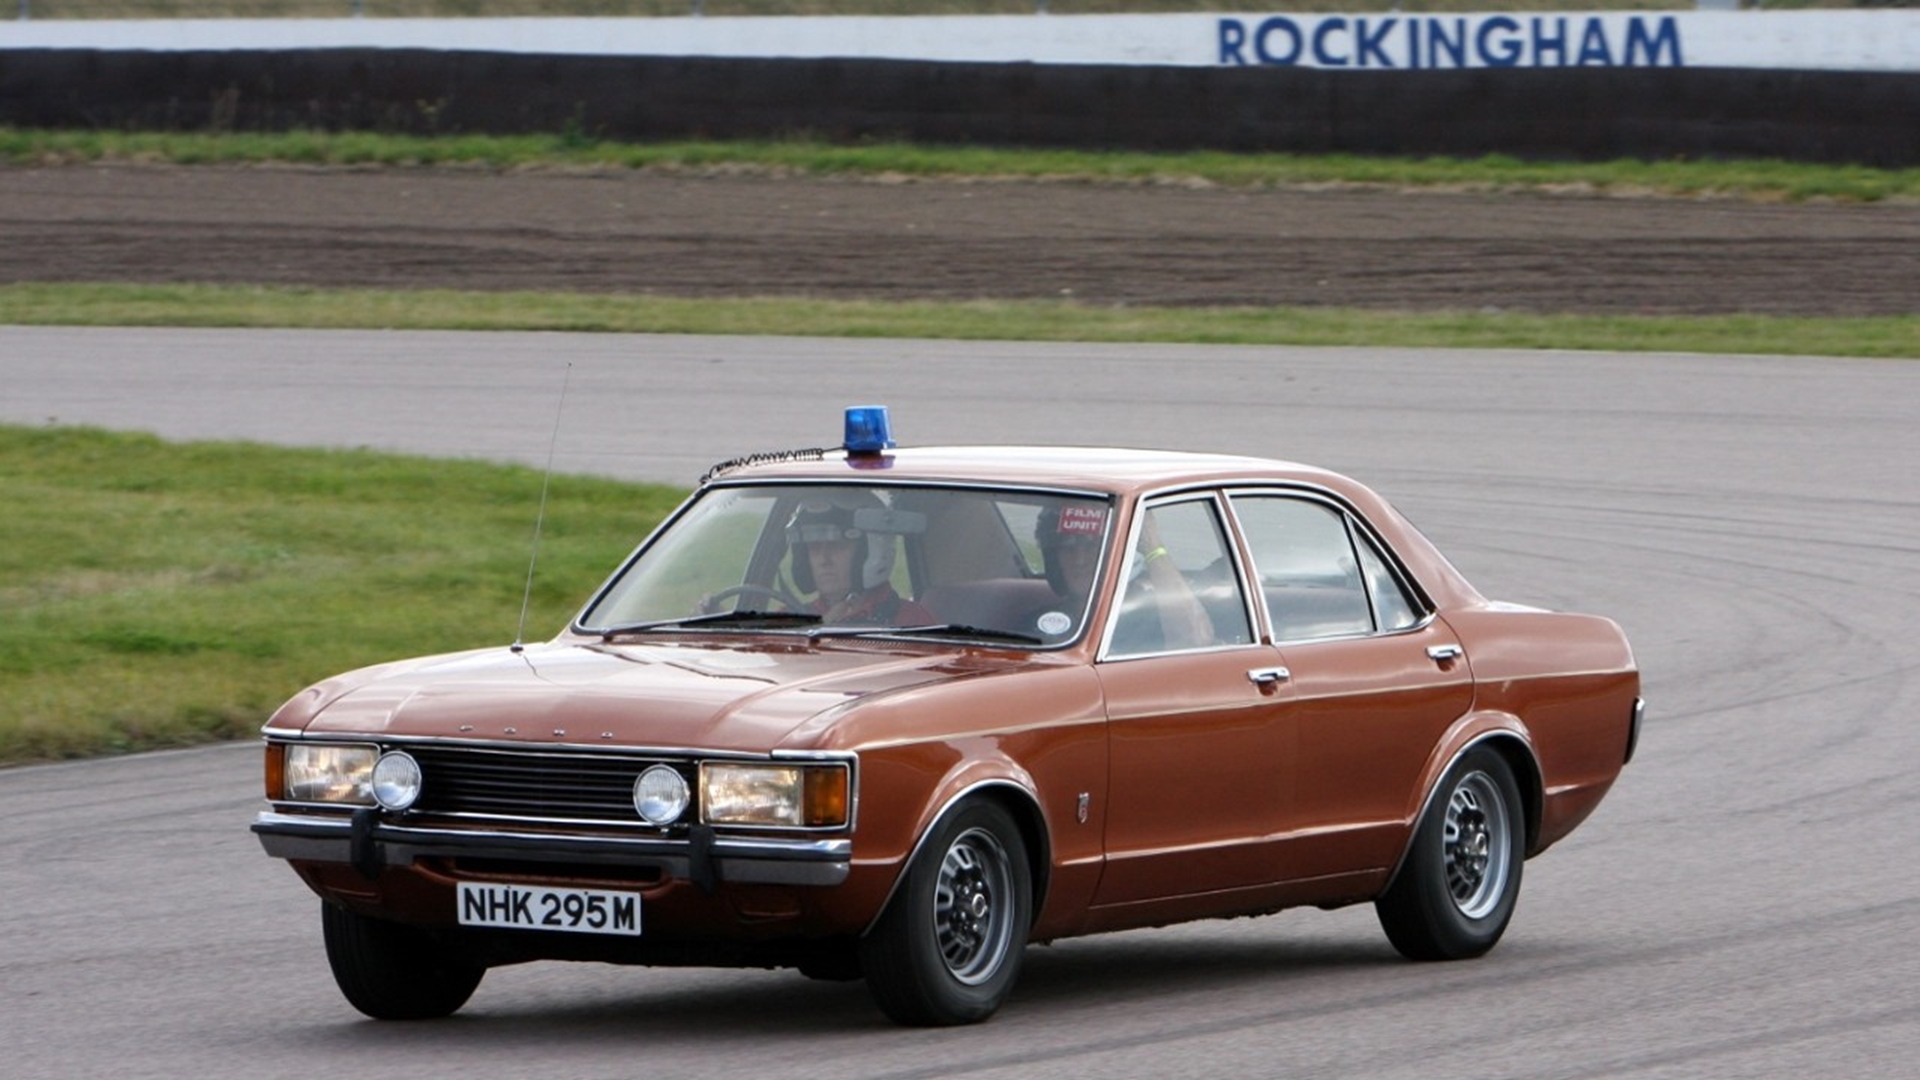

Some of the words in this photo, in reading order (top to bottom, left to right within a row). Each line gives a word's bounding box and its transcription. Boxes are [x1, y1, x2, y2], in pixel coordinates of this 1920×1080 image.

[1217, 16, 1683, 69] ROCKINGHAM
[1063, 520, 1099, 530] UNIT
[1065, 508, 1102, 518] FILM
[463, 887, 534, 925] NHK
